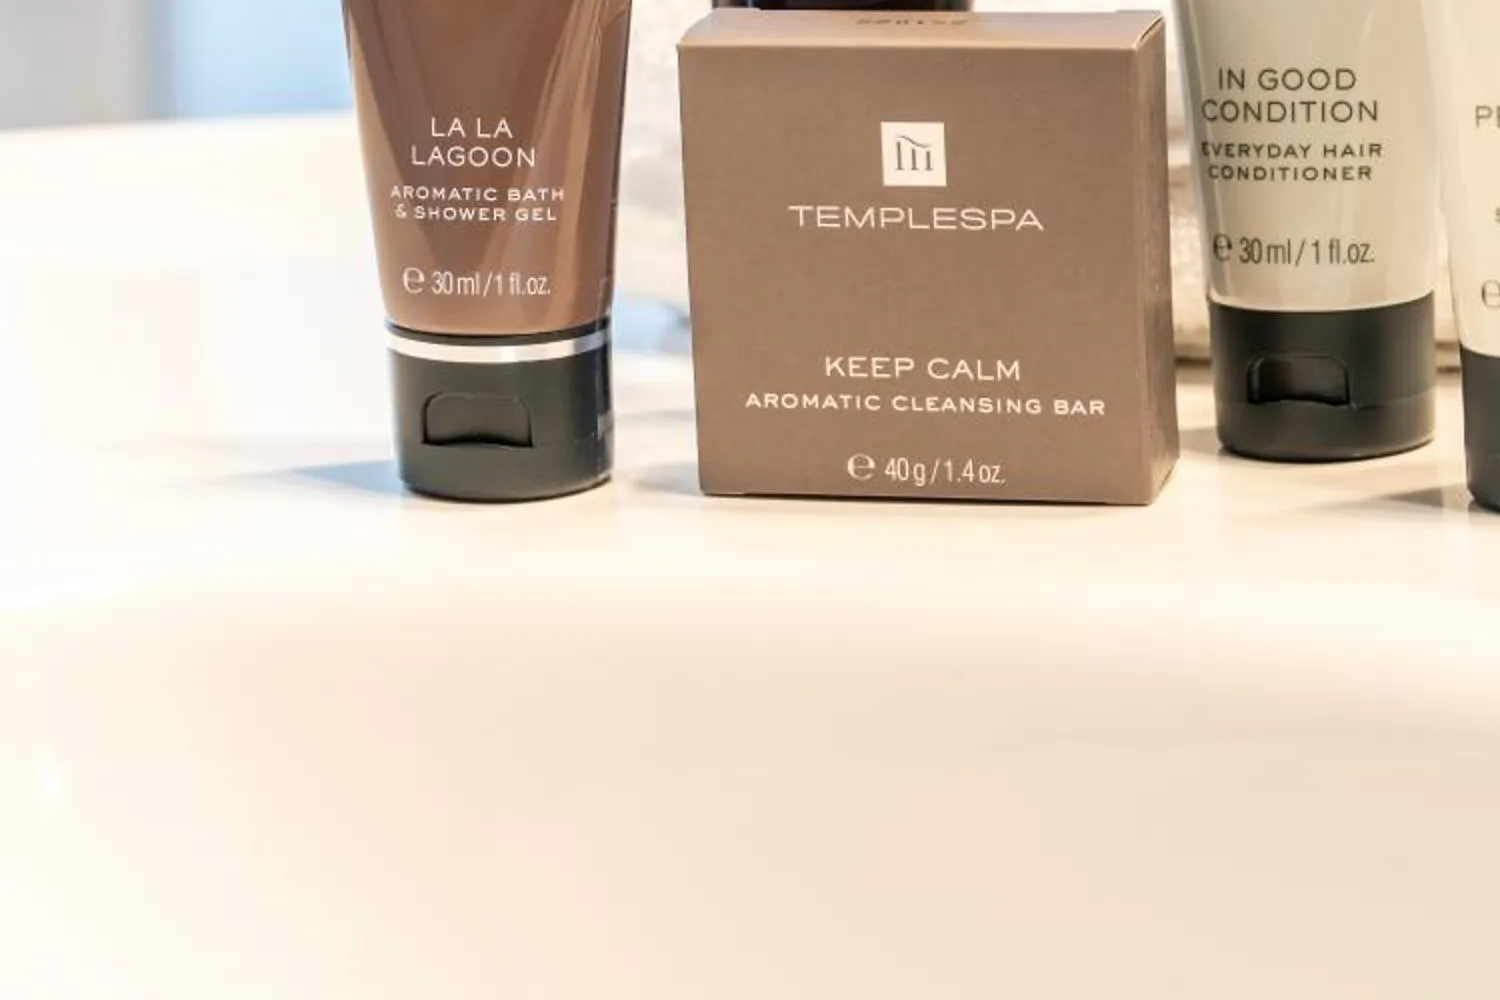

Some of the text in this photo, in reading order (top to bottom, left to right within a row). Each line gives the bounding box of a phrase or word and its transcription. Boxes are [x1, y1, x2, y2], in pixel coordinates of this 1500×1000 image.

[1218, 67, 1357, 91] IN GOOD
[1201, 99, 1378, 123] CONDITION
[431, 117, 513, 138] LA LA
[411, 145, 536, 167] LAGOON
[1201, 141, 1383, 159] EVERYDAY HAIR
[1208, 165, 1372, 181] CONDITIONER
[390, 185, 565, 201] AROMATIC BATH
[395, 203, 557, 221] & SHOWER GEL
[788, 205, 1044, 231] TEMPLESPA
[825, 355, 1020, 381] KEEP CALM
[745, 393, 1105, 416] AROMATIC CLEANSING BAR
